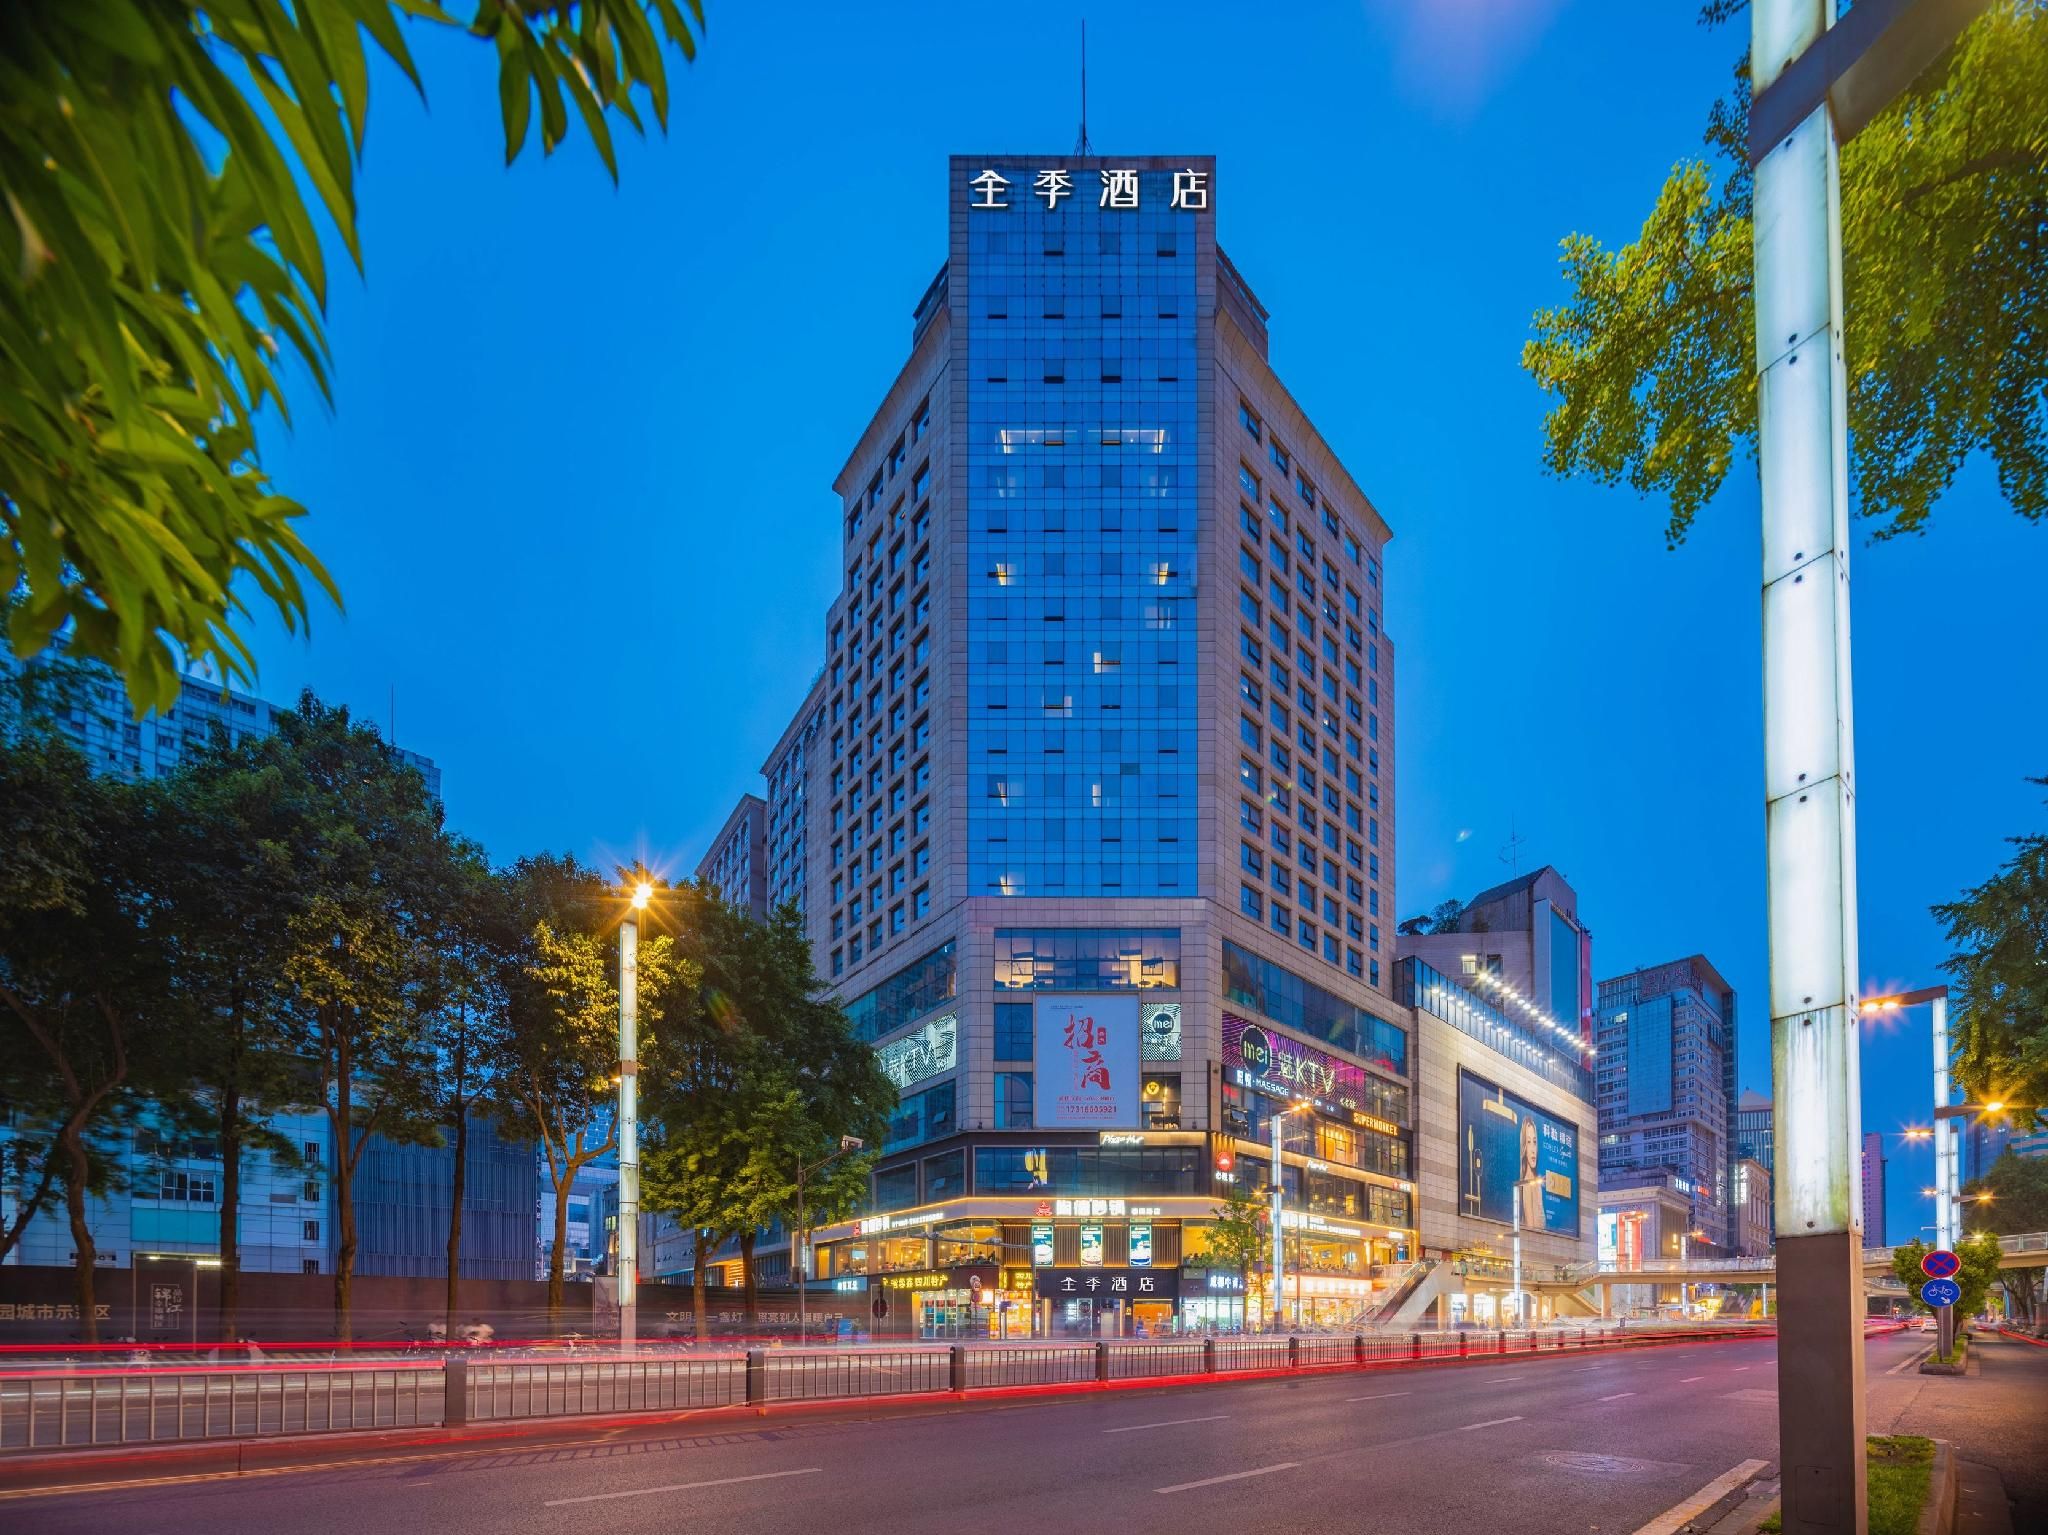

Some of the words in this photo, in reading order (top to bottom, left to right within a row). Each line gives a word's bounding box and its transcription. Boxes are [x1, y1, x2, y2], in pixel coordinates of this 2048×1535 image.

[969, 168, 1208, 209] 全季酒店
[1060, 1276, 1155, 1292] 全季酒店
[0, 1303, 112, 1321] 园城市示区
[666, 1311, 744, 1324] 文明一盏灯
